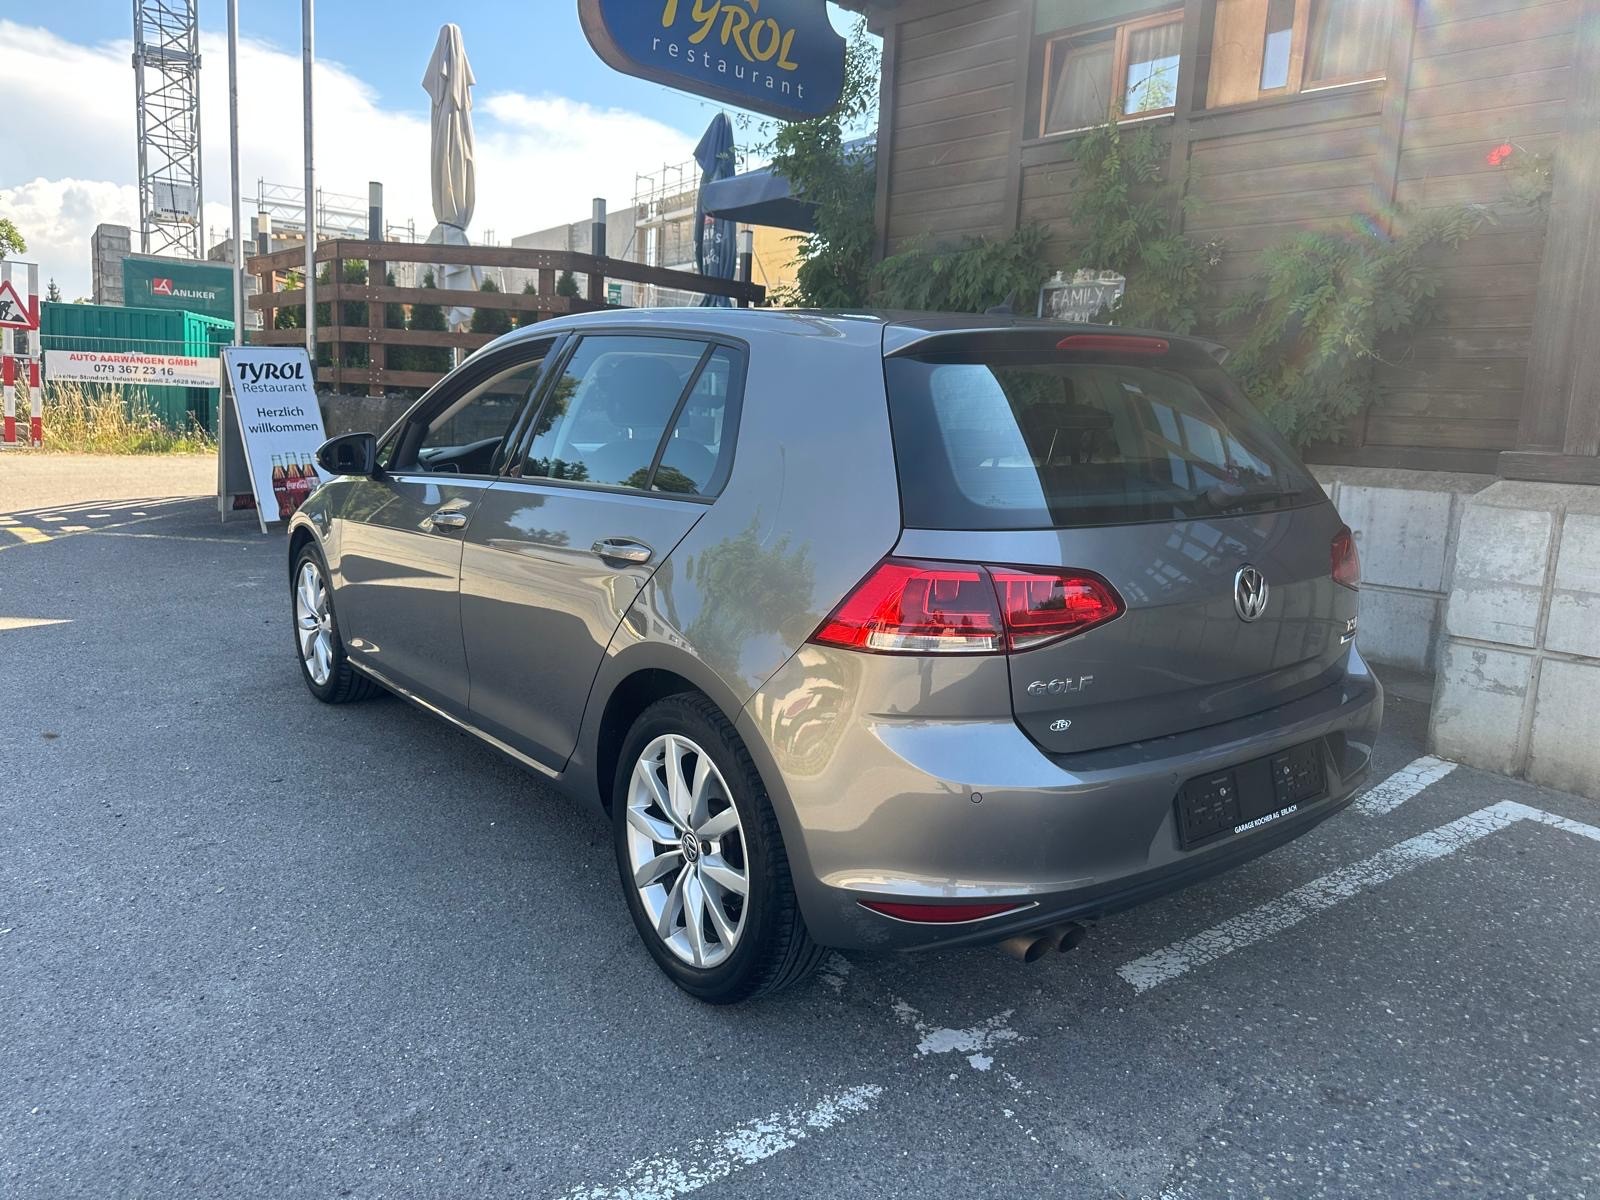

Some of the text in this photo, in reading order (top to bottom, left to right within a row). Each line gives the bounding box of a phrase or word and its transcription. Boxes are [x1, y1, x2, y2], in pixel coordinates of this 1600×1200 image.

[652, 36, 804, 99] restaurant
[172, 289, 216, 300] ANLIKER
[1052, 286, 1105, 310] FAMILY
[69, 353, 198, 367] AUTO AARWANGEN GMBH
[94, 364, 174, 376] 079 367 23 16
[236, 362, 305, 384] TYROL
[242, 382, 308, 393] Restaurant
[256, 406, 304, 418] Herzlich
[248, 422, 319, 434] willkommen
[1027, 675, 1094, 696] GOLF
[1234, 820, 1255, 834] GARAGE
